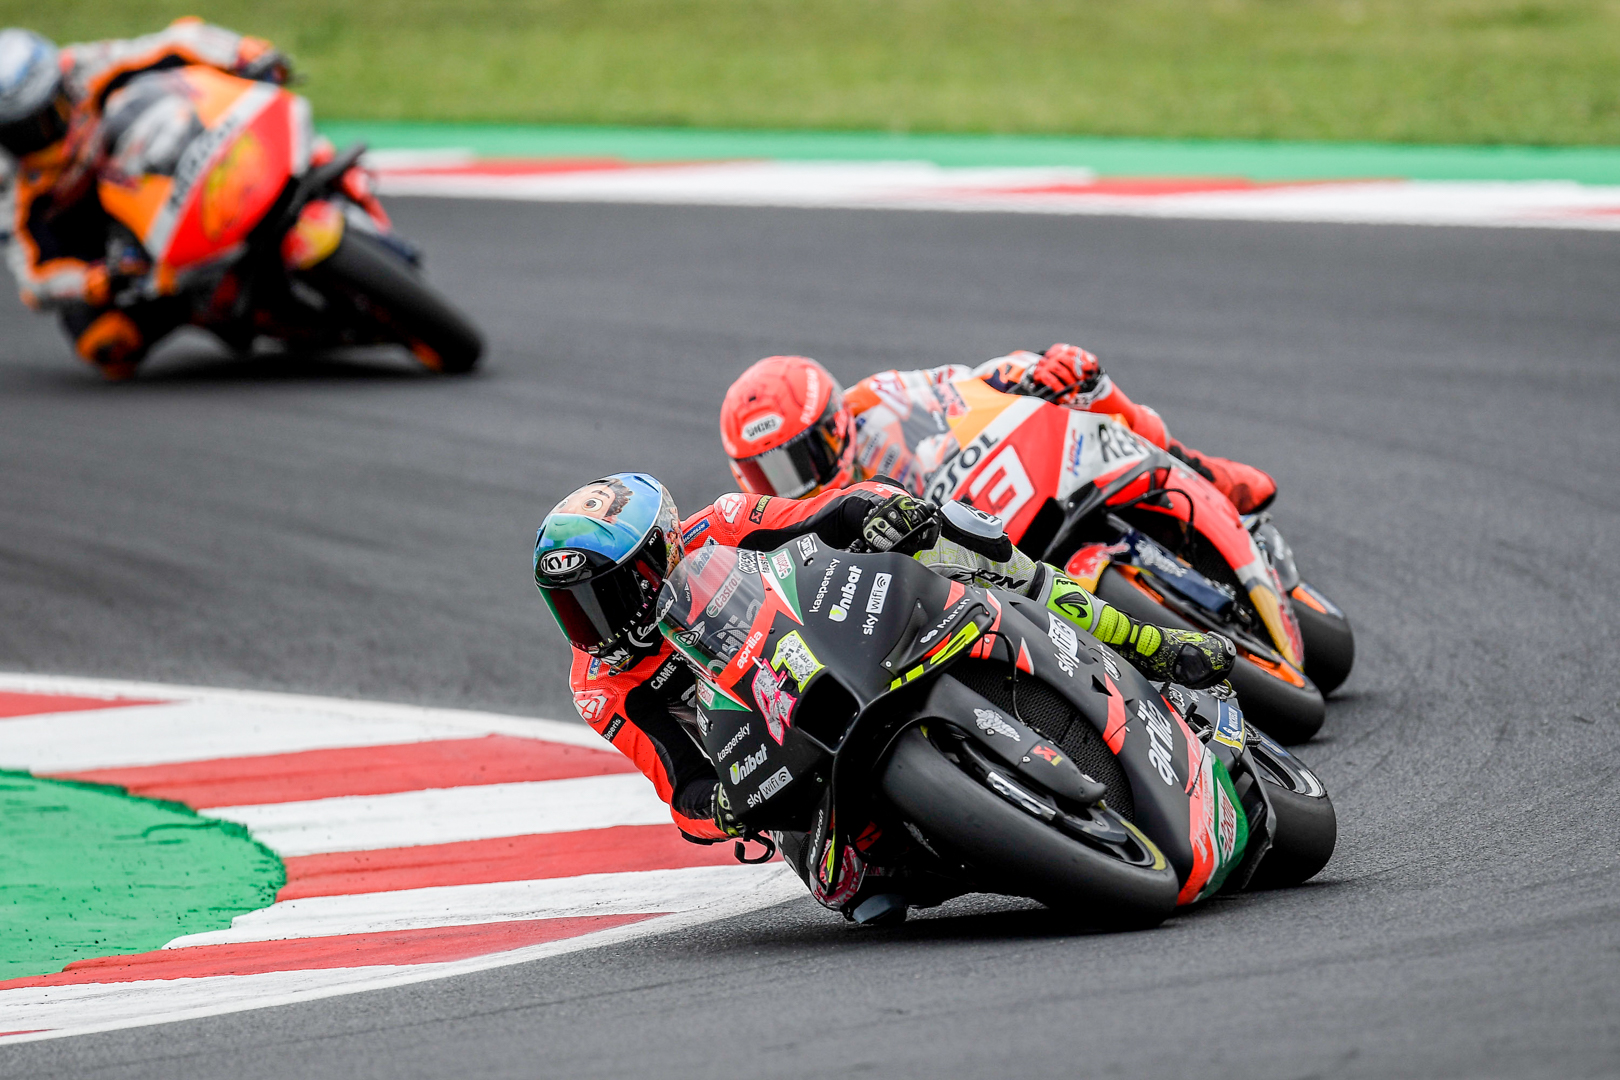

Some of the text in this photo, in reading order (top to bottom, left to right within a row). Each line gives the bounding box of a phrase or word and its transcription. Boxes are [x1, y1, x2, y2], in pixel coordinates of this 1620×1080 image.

[542, 551, 581, 571] KYT
[714, 573, 742, 609] Castrol
[809, 558, 840, 613] kaspersky
[828, 565, 863, 622] Unibat
[862, 587, 885, 636] sky wifi
[937, 598, 971, 629] Marsh
[736, 630, 764, 669] aprilia
[1053, 648, 1080, 677] sky
[650, 661, 677, 690] CAME
[717, 723, 750, 762] kaspersky
[1136, 699, 1181, 787] aprilia
[729, 743, 768, 786] Unibat
[747, 778, 780, 809] sky wifi
